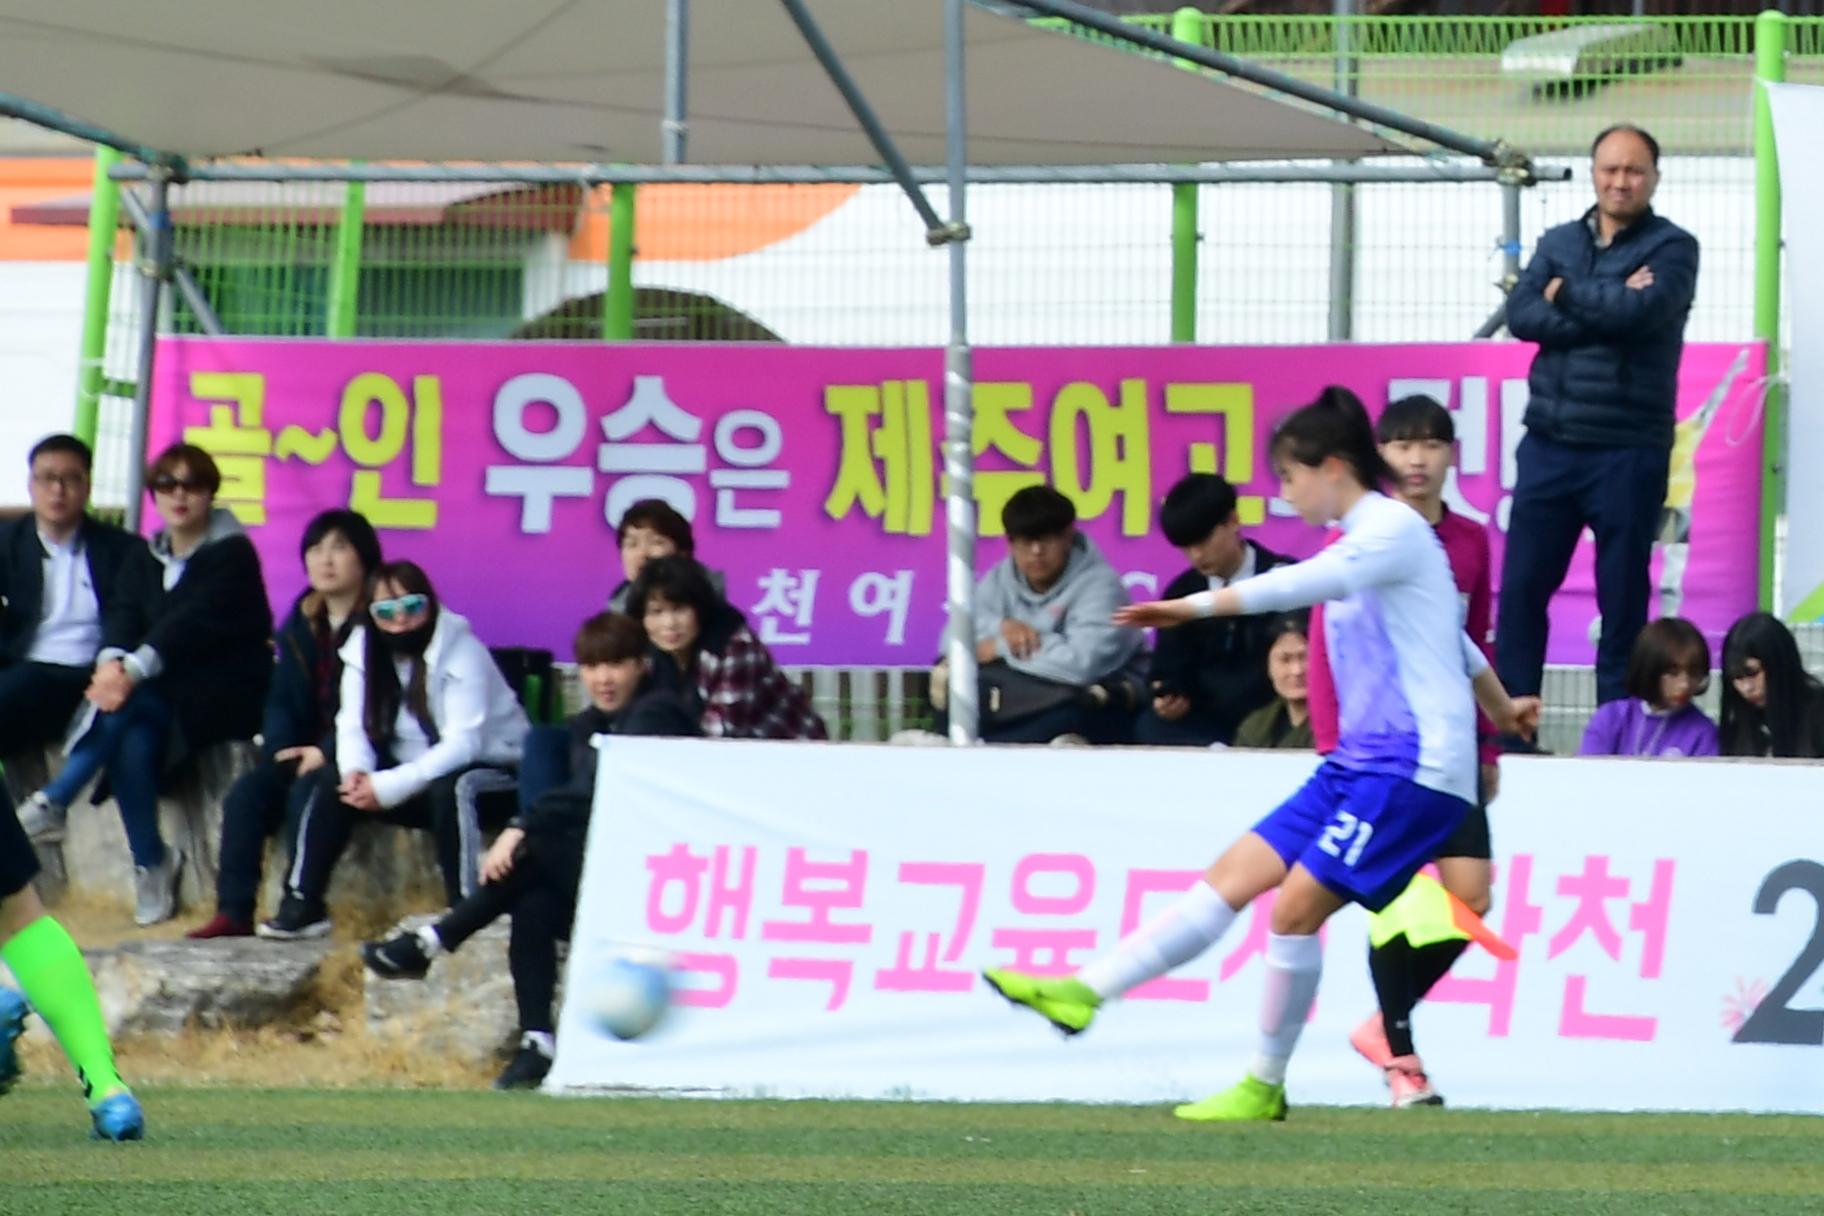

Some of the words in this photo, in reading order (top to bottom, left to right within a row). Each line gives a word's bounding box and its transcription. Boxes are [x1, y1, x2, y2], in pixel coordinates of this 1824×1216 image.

[181, 370, 443, 531] 골~인
[484, 372, 791, 534] 우승은
[824, 378, 1302, 537] 제주여고
[1318, 809, 1374, 867] 21
